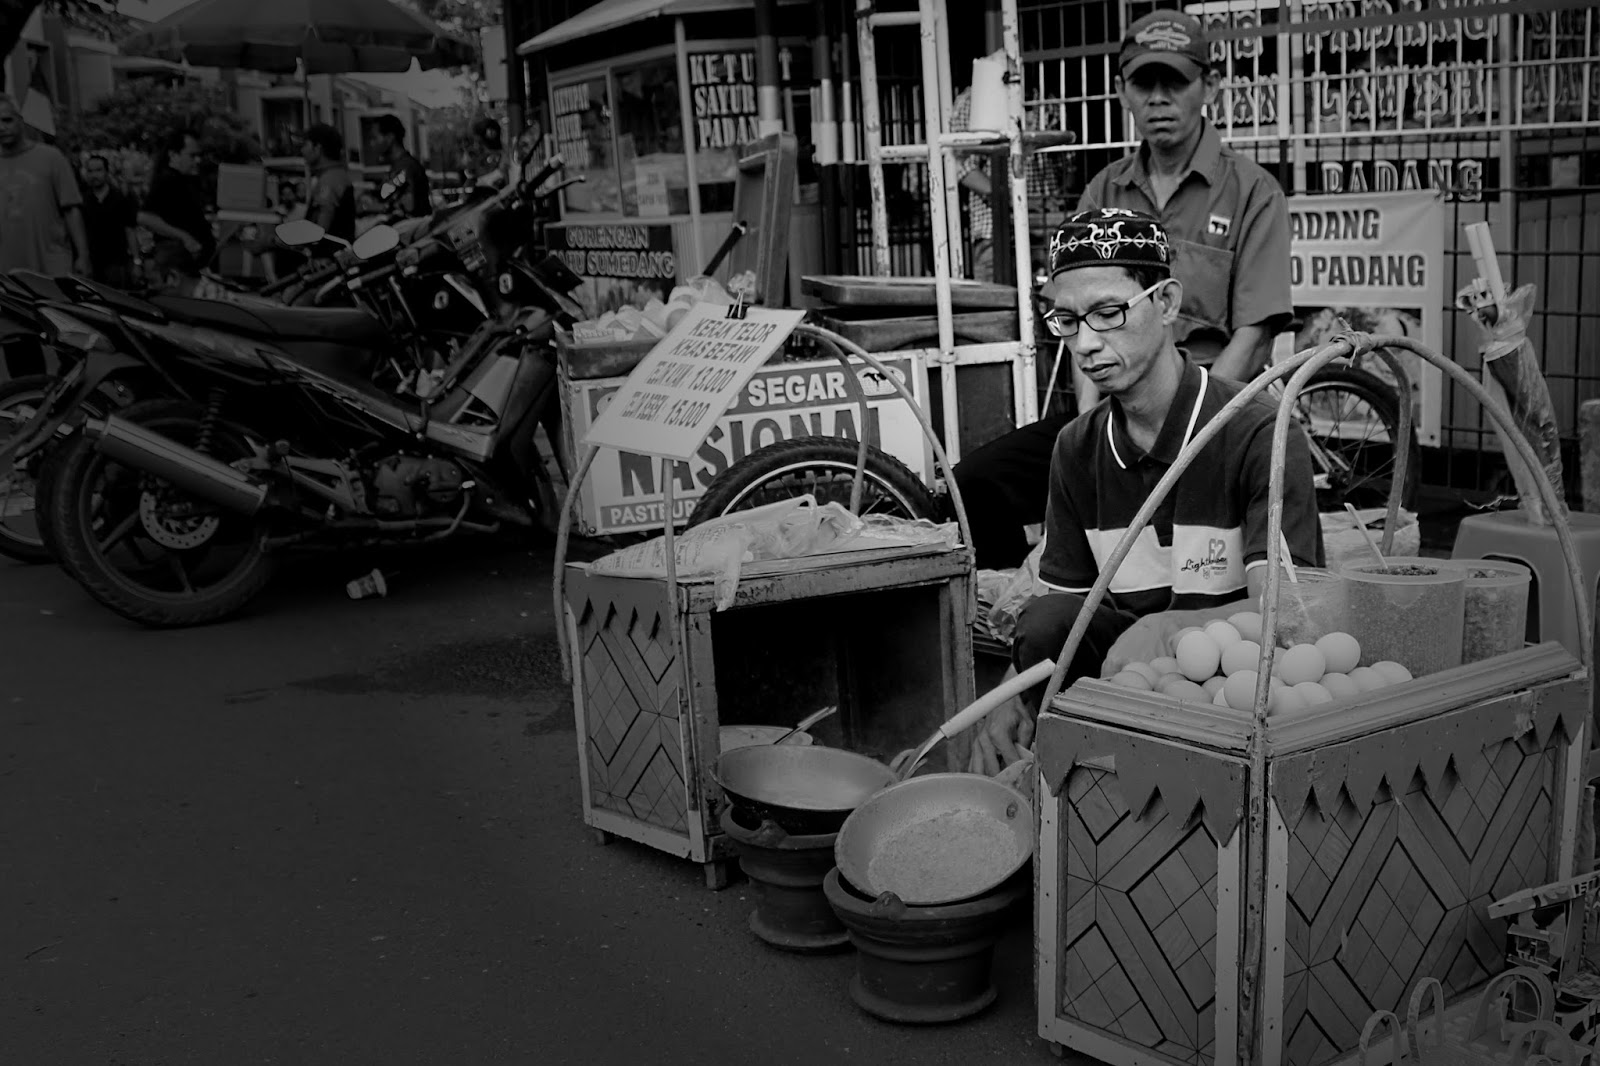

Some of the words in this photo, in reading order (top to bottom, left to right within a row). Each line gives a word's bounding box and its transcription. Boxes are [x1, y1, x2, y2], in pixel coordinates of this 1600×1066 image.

[694, 84, 756, 116] SAYUR
[587, 249, 675, 279] SUMEDANG
[1311, 254, 1425, 287] PADANG
[688, 317, 740, 340] KERAK
[732, 321, 777, 344] TELOR
[669, 338, 712, 359] KHAS
[704, 344, 760, 364] BETAWI
[688, 365, 737, 394] 13.000
[748, 371, 847, 407] SEGAR
[663, 398, 711, 429] 15.000
